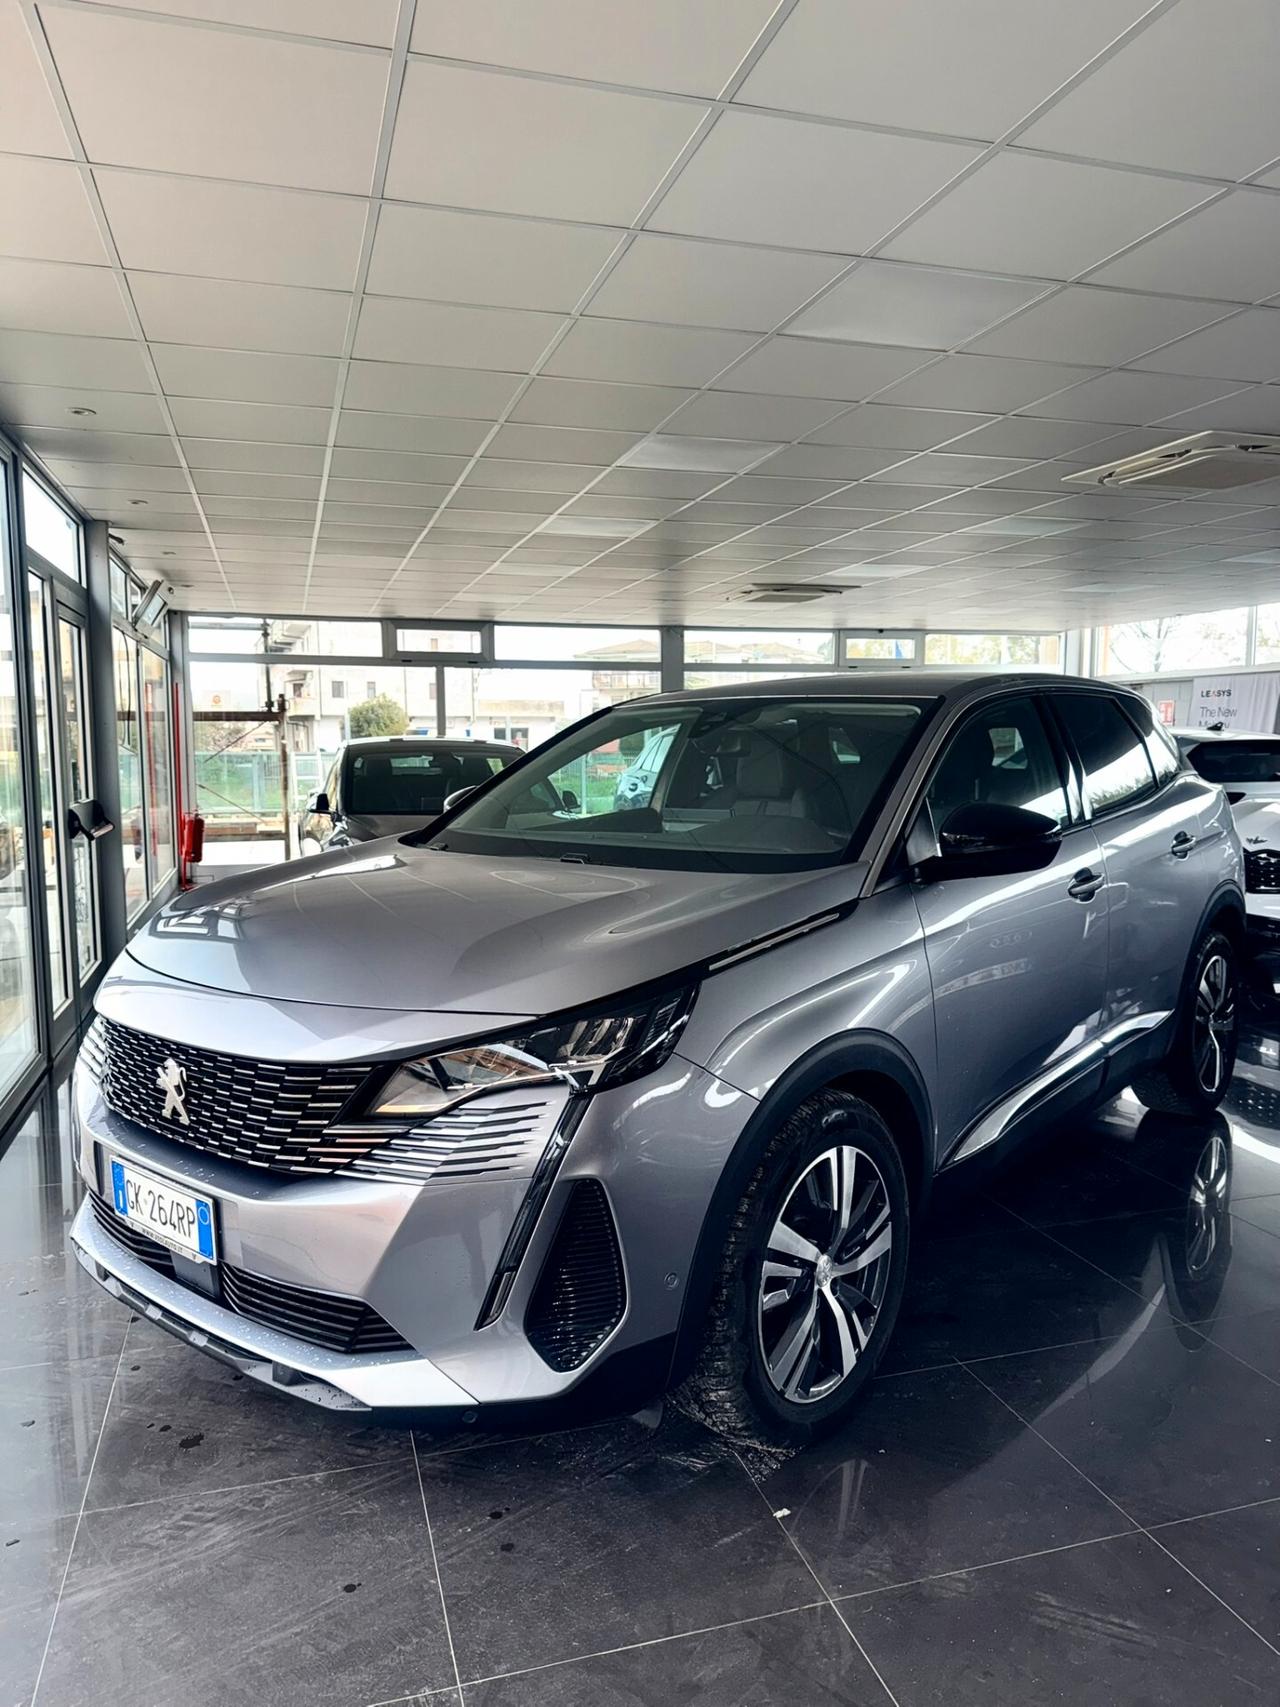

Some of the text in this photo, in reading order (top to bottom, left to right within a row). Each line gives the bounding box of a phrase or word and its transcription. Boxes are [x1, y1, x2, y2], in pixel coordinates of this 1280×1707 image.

[1200, 689, 1232, 698] LEASYS
[1199, 706, 1238, 718] The New
[147, 1189, 196, 1238] 264RP
